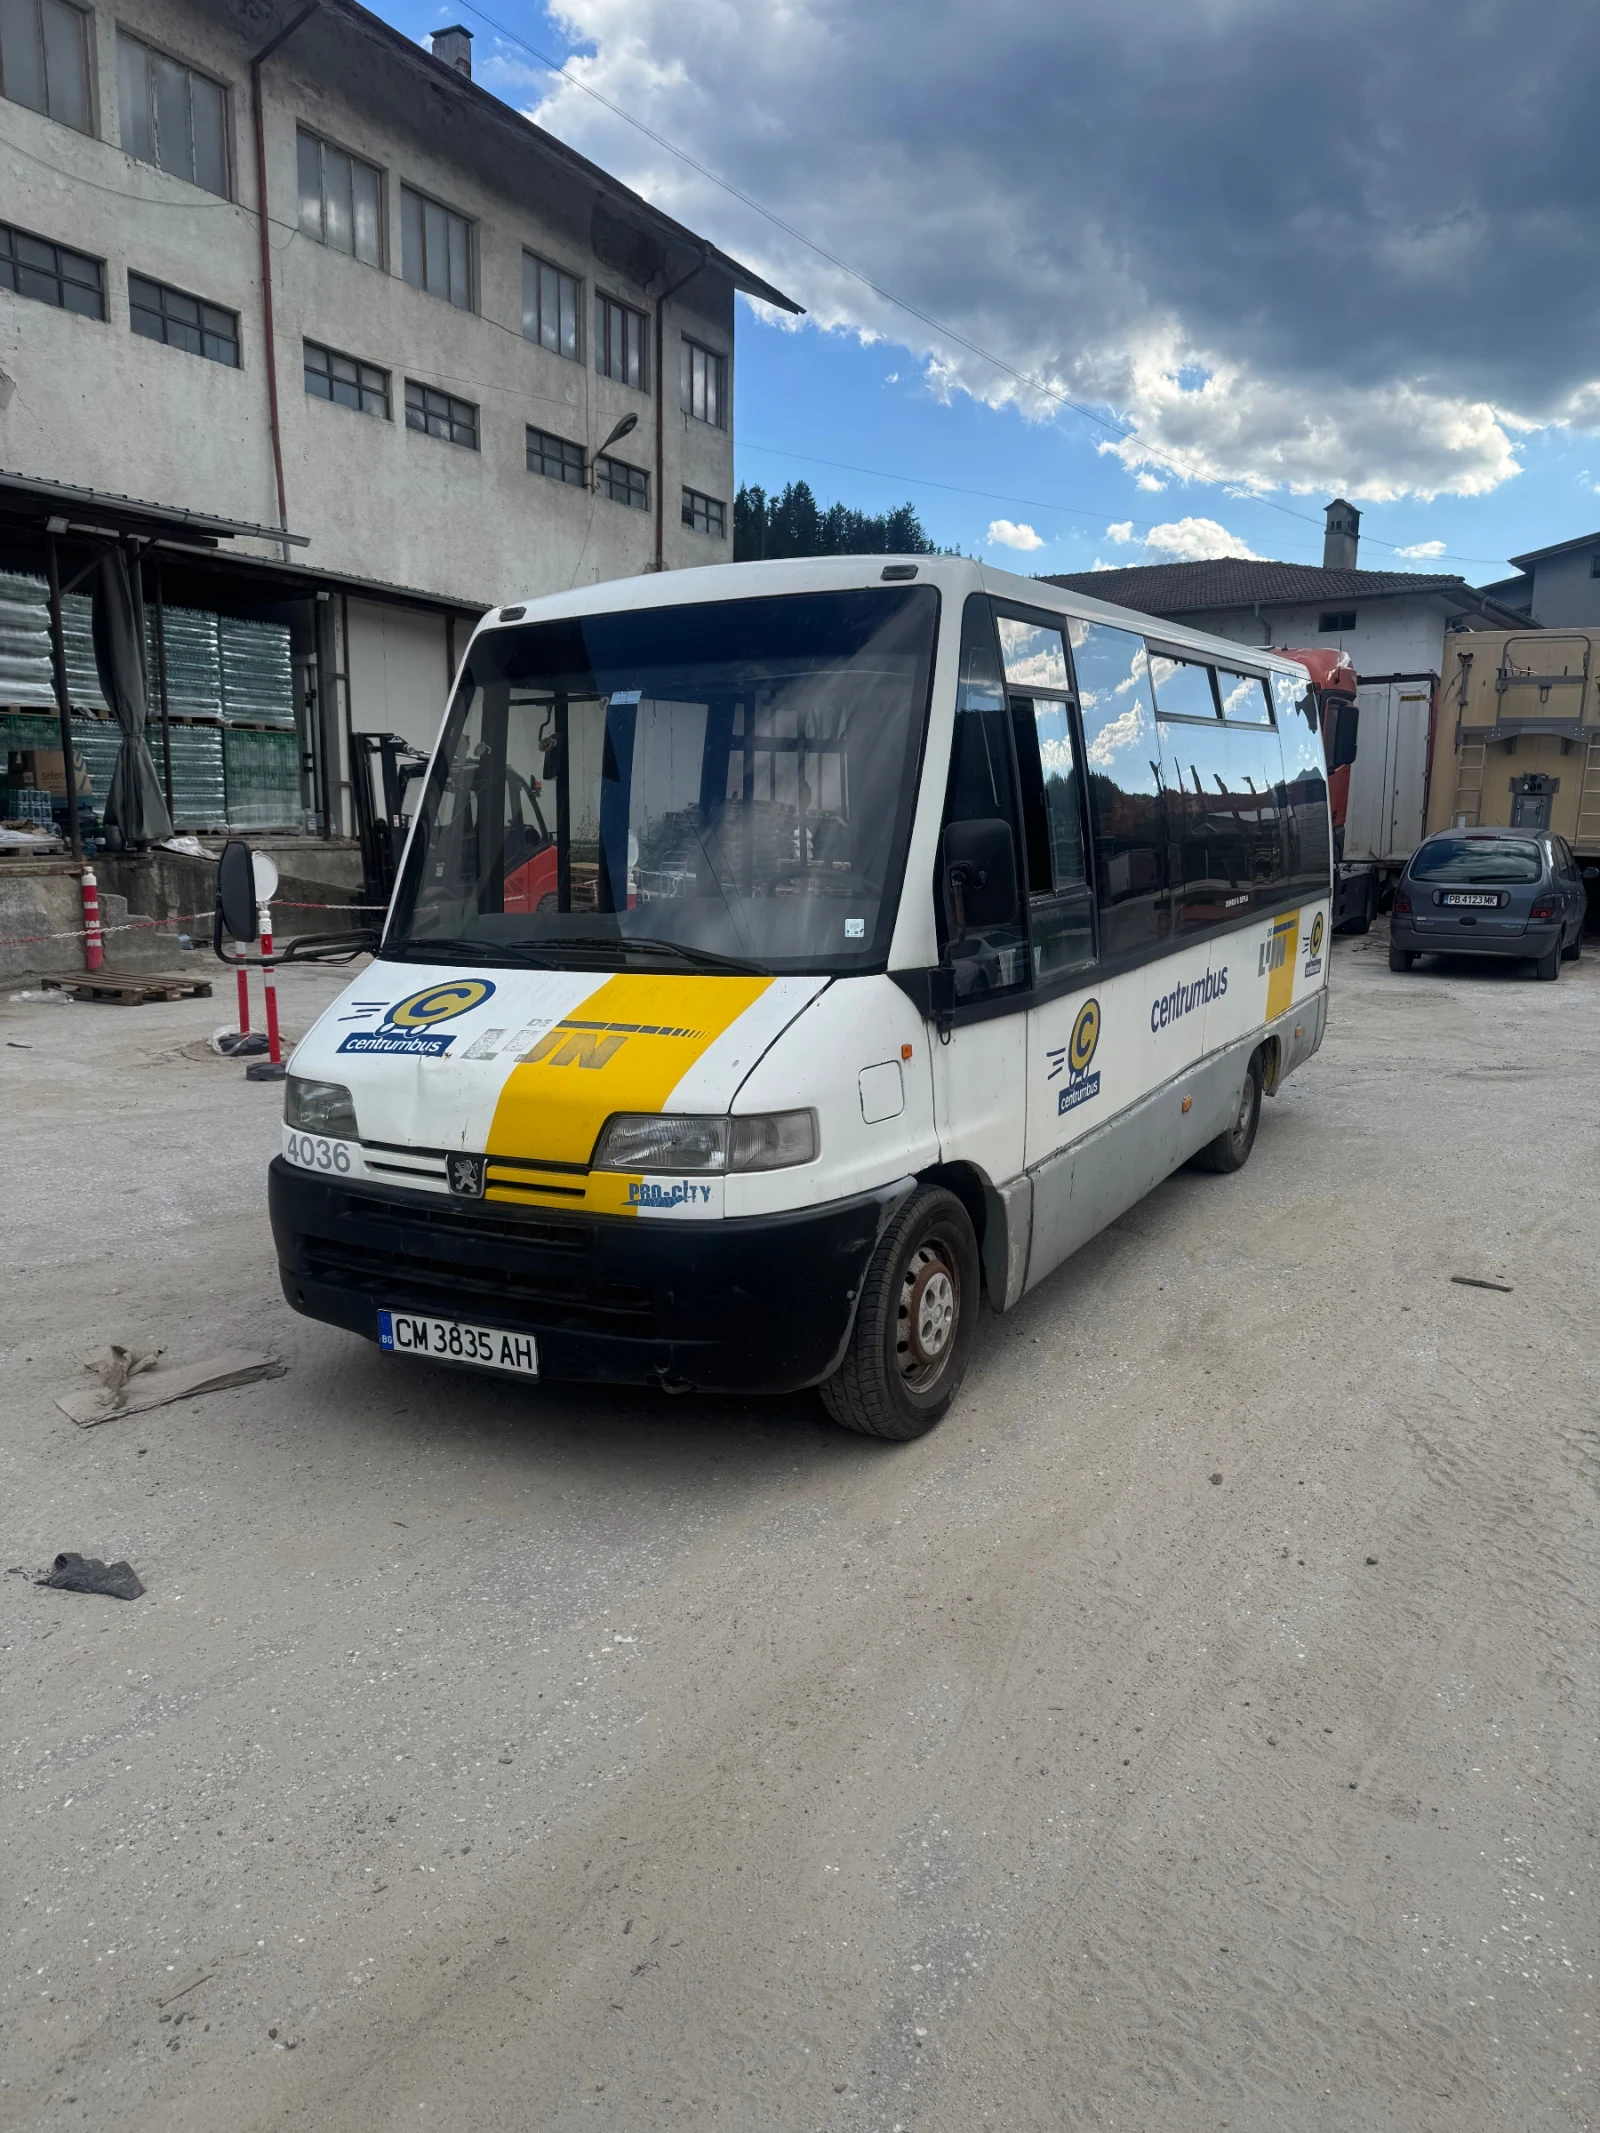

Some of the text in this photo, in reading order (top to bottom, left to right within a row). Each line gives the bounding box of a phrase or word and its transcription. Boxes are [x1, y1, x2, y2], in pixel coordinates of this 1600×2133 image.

[1461, 895, 1483, 905] 4123
[408, 987, 472, 1018] C
[1151, 967, 1228, 1033] centrumbus
[527, 1018, 553, 1027] DE
[1076, 1011, 1094, 1058] C
[345, 1036, 443, 1053] centrumbus
[459, 1028, 629, 1069] LIJN
[1060, 1080, 1098, 1110] centrumbus
[287, 1133, 351, 1173] 4036
[381, 1334, 393, 1344] BG
[395, 1318, 533, 1370] CM 3835 AH
